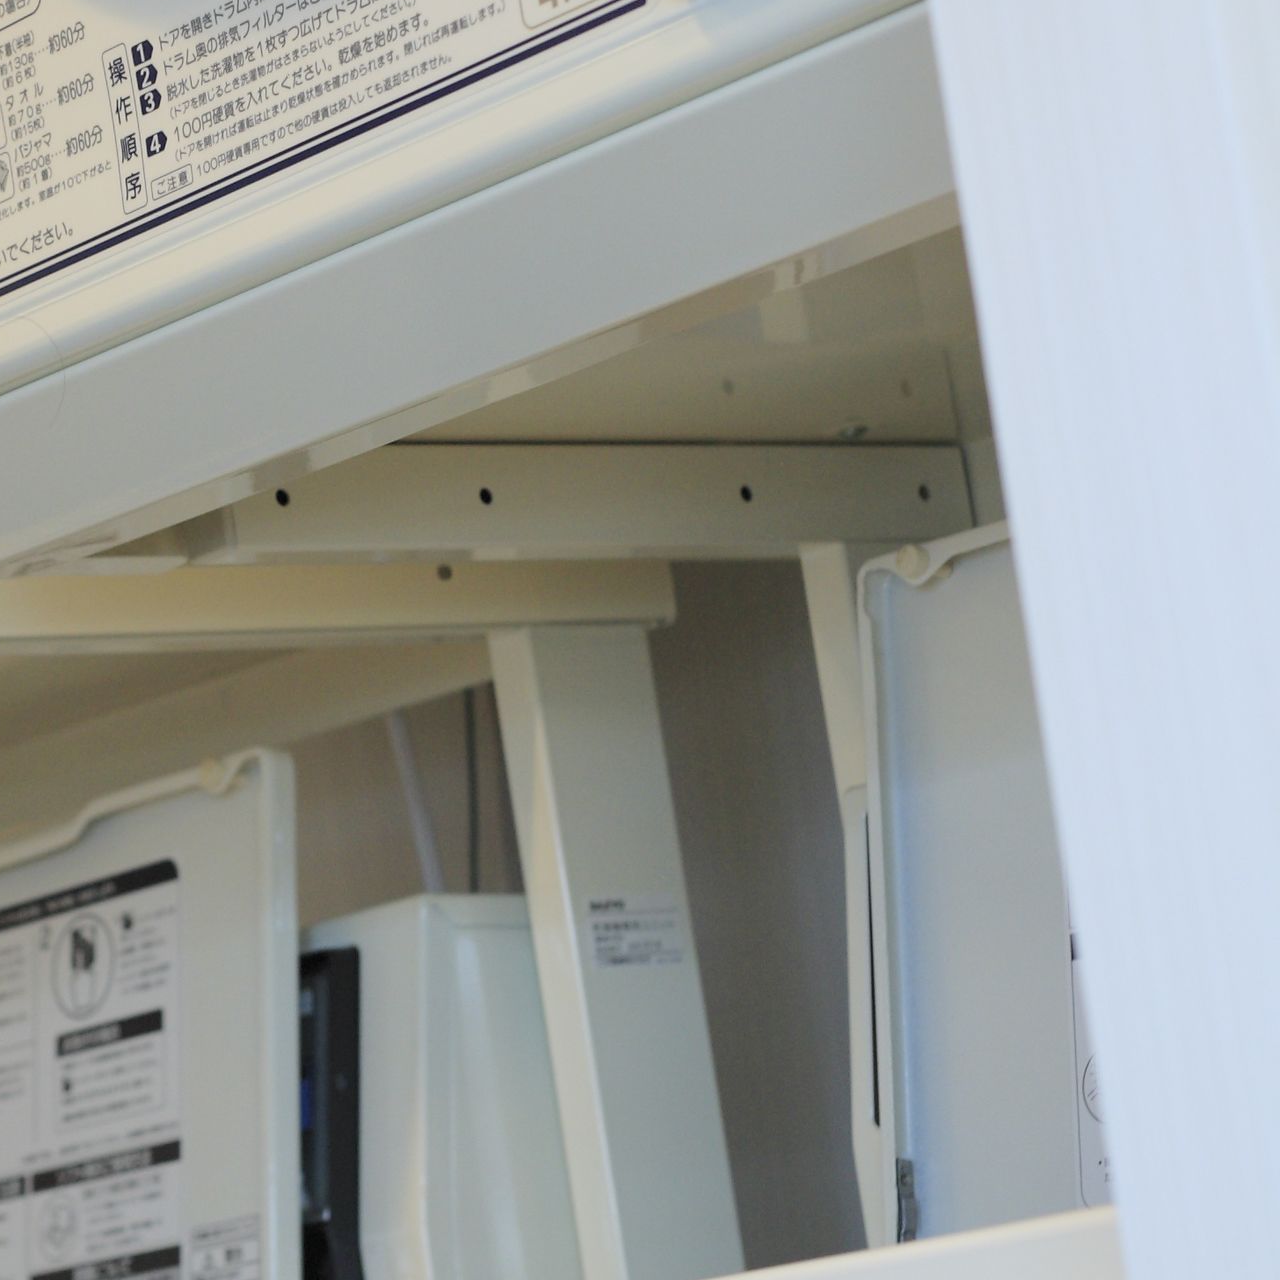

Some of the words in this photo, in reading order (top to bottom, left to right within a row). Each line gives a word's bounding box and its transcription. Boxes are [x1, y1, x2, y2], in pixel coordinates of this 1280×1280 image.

[48, 20, 85, 54] 約60分
[136, 42, 147, 63] 1
[57, 71, 95, 106] 約60分
[140, 65, 152, 89] 2
[148, 133, 161, 155] 4
[173, 9, 428, 143] 100円硬貨を入れてください。乾燥を始めます。
[5, 80, 44, 111] タオル
[143, 90, 156, 114] 3
[65, 122, 103, 157] 約60分
[108, 55, 144, 202] 操作順序
[13, 131, 52, 162] パジャマ
[156, 169, 189, 196] ご注意
